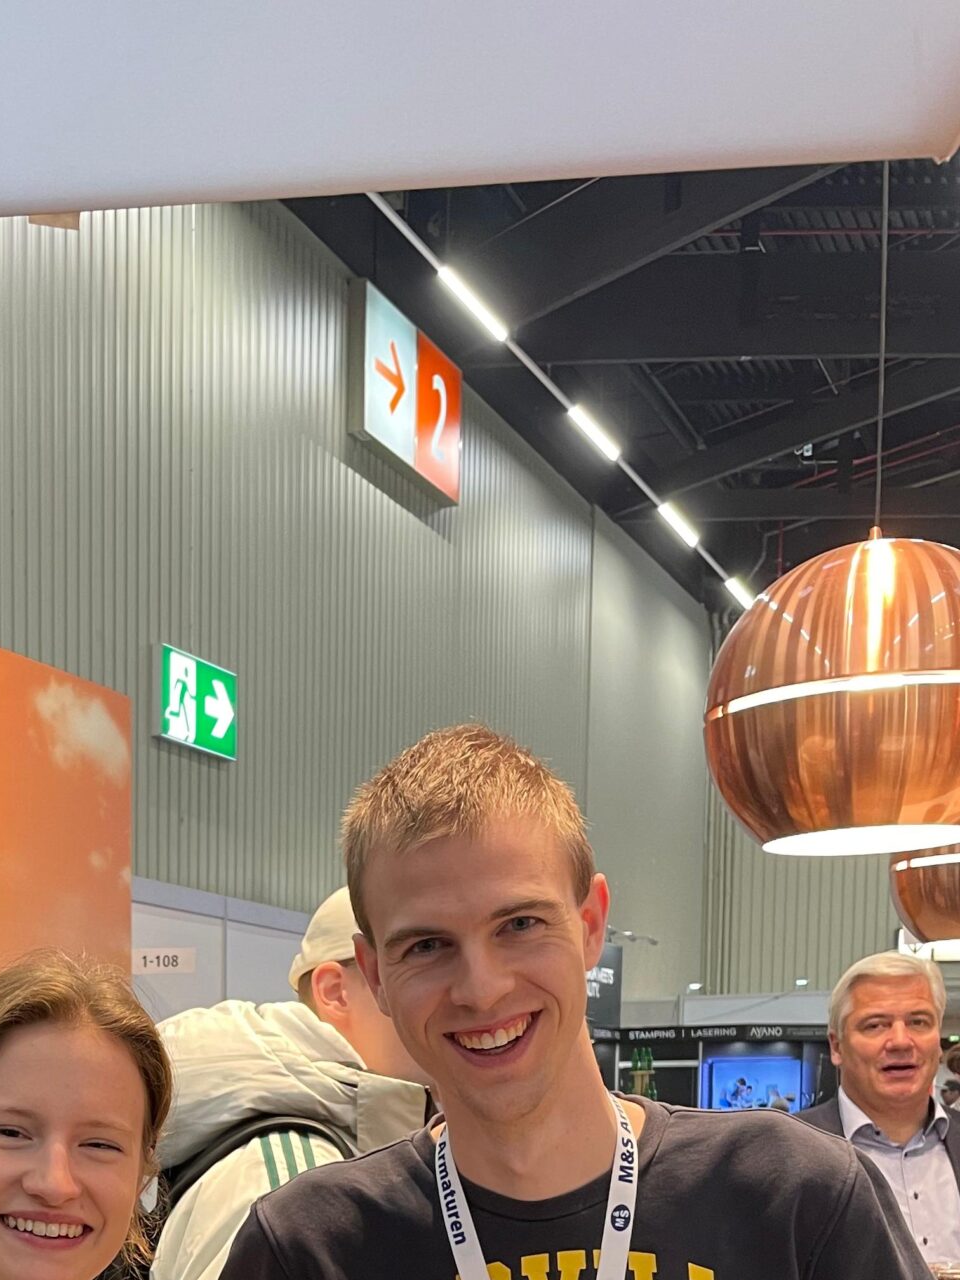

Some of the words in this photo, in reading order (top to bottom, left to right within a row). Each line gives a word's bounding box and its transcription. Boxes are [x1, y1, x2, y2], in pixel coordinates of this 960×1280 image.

[432, 374, 447, 459] 2
[142, 955, 179, 968] 1-108
[629, 1030, 675, 1041] STAMPING
[691, 1027, 737, 1038] LASERING
[618, 1137, 635, 1184] M&S
[436, 1141, 467, 1246] Armaturen
